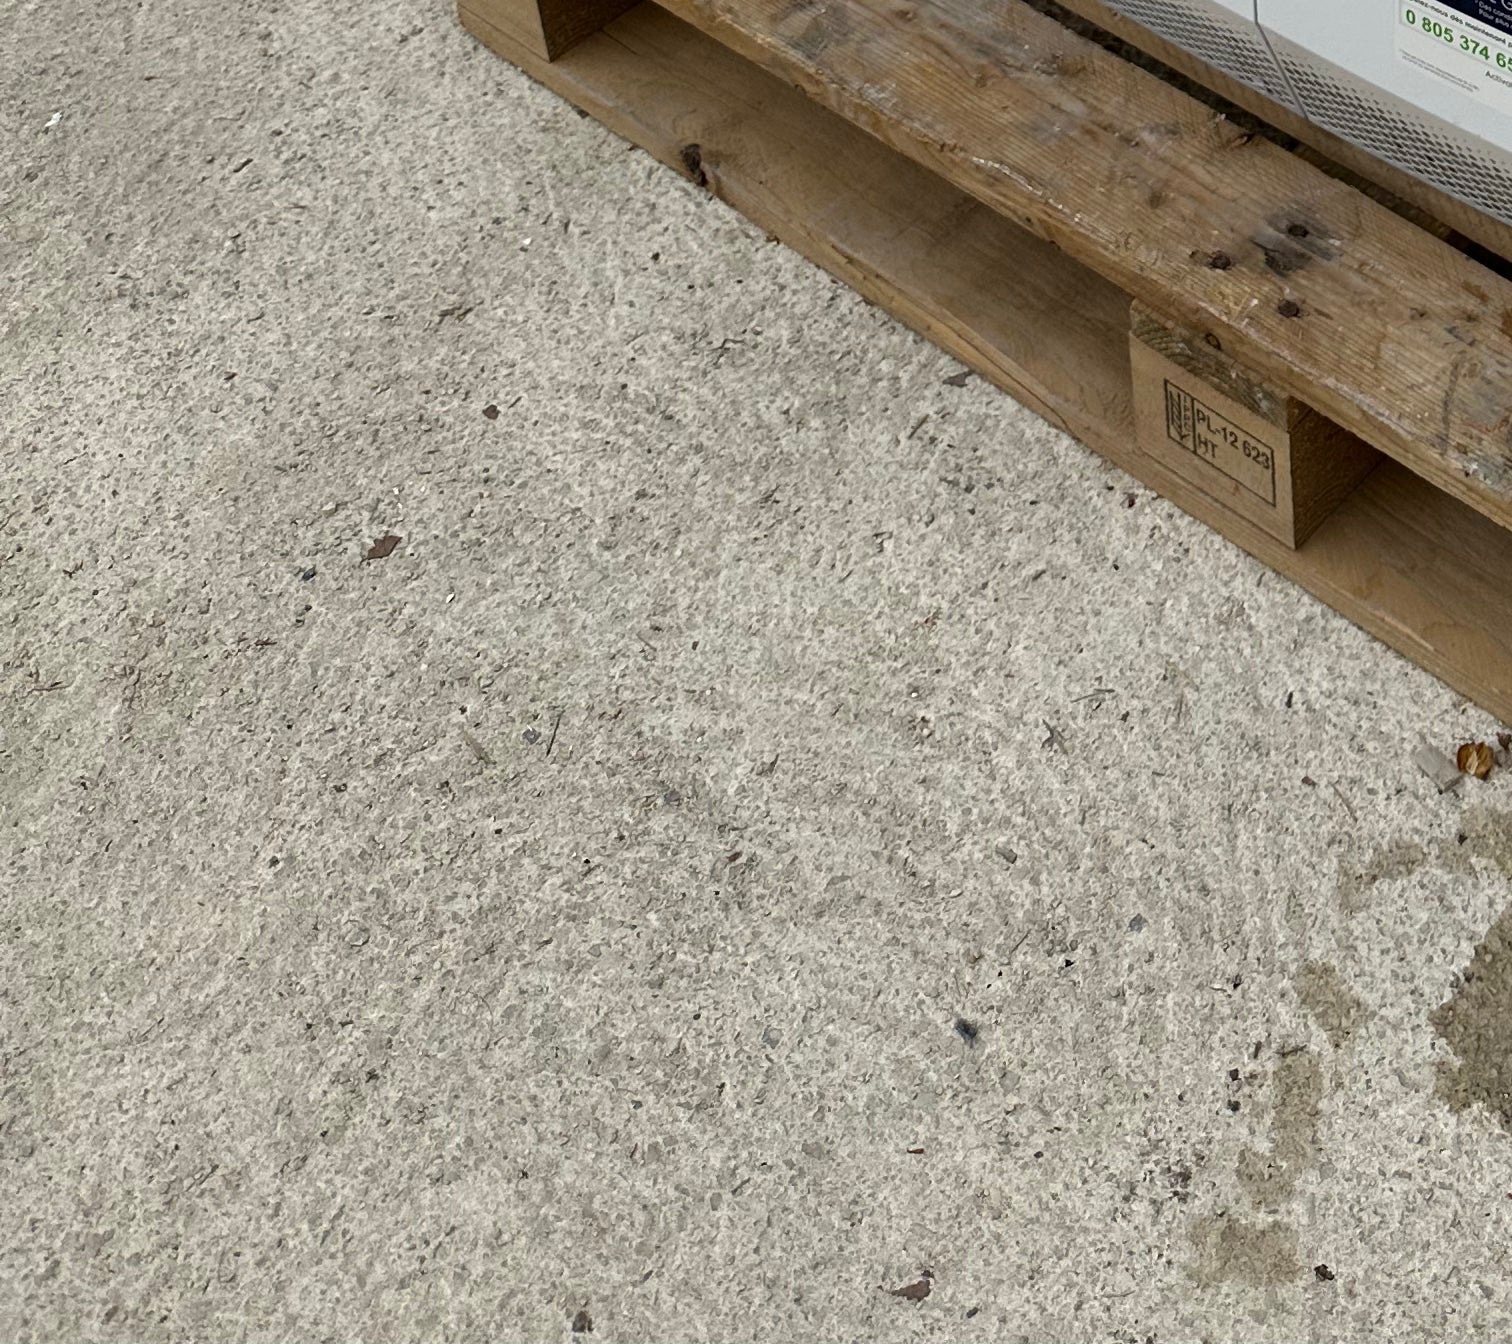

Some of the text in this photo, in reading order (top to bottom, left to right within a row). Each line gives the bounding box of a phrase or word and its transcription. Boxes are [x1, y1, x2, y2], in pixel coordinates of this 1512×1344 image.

[1406, 8, 1415, 26] 0
[1422, 16, 1453, 44] 805
[1460, 33, 1489, 61] 374
[1197, 433, 1218, 459] HT
[1242, 441, 1270, 470] 623
